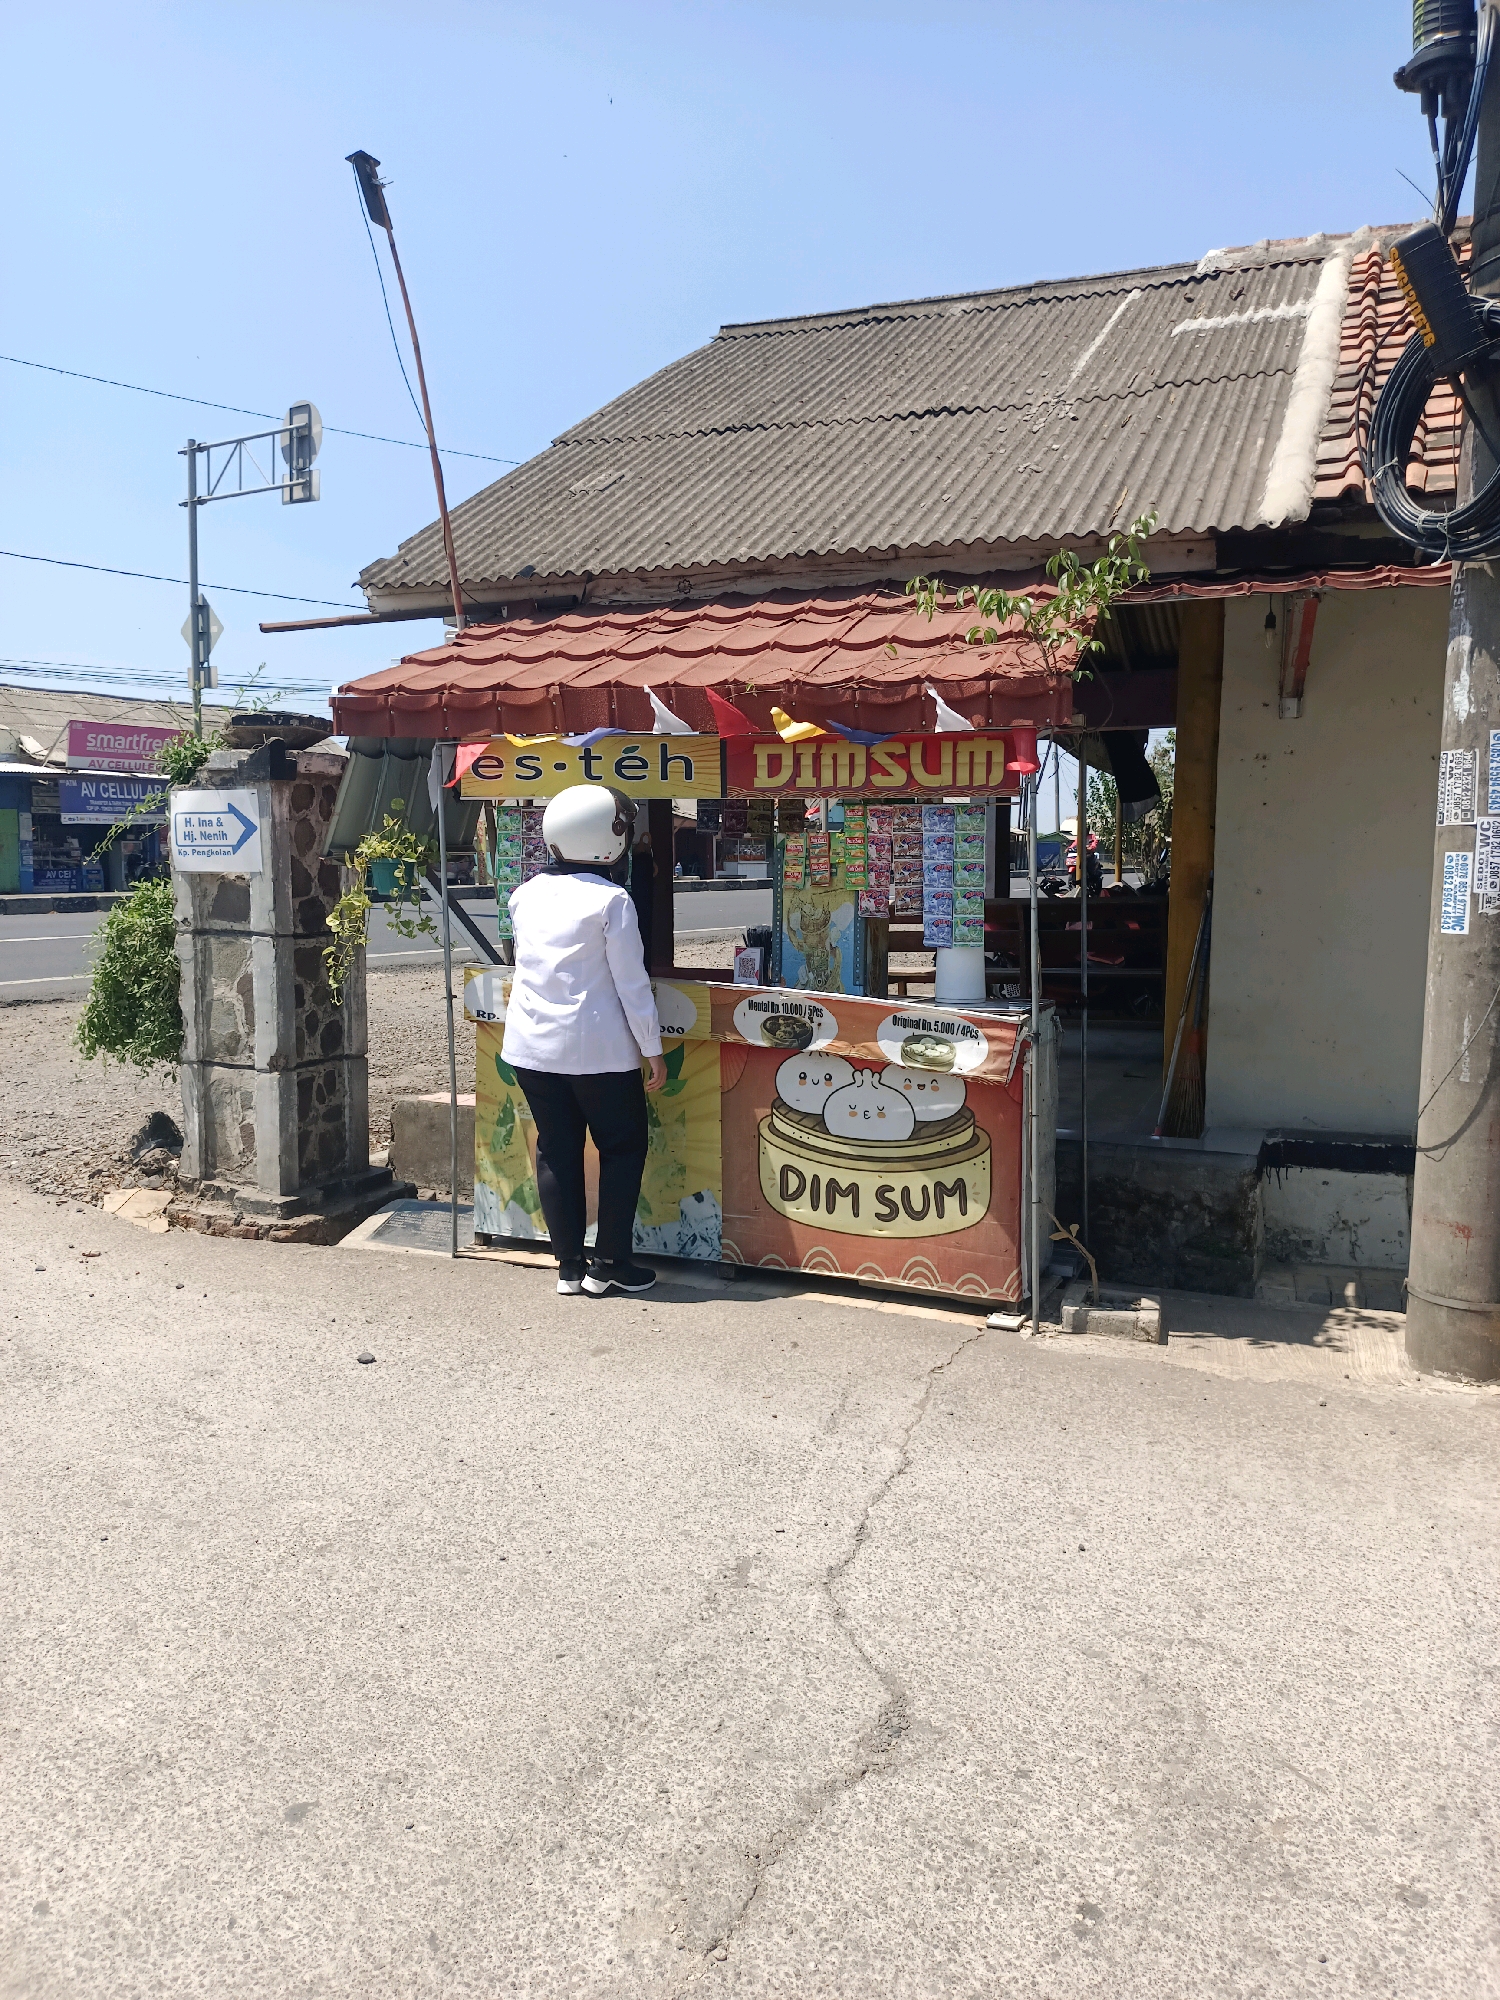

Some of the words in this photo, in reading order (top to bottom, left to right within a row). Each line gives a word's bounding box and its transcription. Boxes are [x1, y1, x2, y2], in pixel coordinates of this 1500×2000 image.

[88, 760, 105, 768] AV
[753, 737, 1005, 788] DIMSUM
[81, 781, 96, 798] AV
[100, 782, 162, 800] CELLULAR
[184, 817, 195, 828] H.
[198, 817, 213, 828] Ina
[216, 816, 224, 827] &
[183, 830, 197, 843] Hj.
[200, 830, 228, 841] Nenih
[1479, 821, 1491, 849] WC
[178, 848, 190, 857] Kp.
[191, 848, 232, 858] Pengkolan
[1490, 841, 1500, 859] 1782
[1444, 864, 1455, 886] 0852
[1489, 862, 1500, 879] 0857
[1442, 887, 1453, 908] 9594
[1441, 909, 1452, 930] 4543
[1451, 915, 1465, 931] WC
[475, 1009, 500, 1021] Rp.
[770, 1001, 781, 1014] Rp.
[781, 1002, 803, 1017] 10.000
[808, 1005, 824, 1018] 5Pcs
[892, 1014, 921, 1030] Original
[921, 1018, 933, 1033] Rp.
[933, 1020, 955, 1036] 5.000
[960, 1024, 980, 1040] 4Pcs
[779, 1164, 860, 1218] DIM
[874, 1177, 968, 1223] SUM
